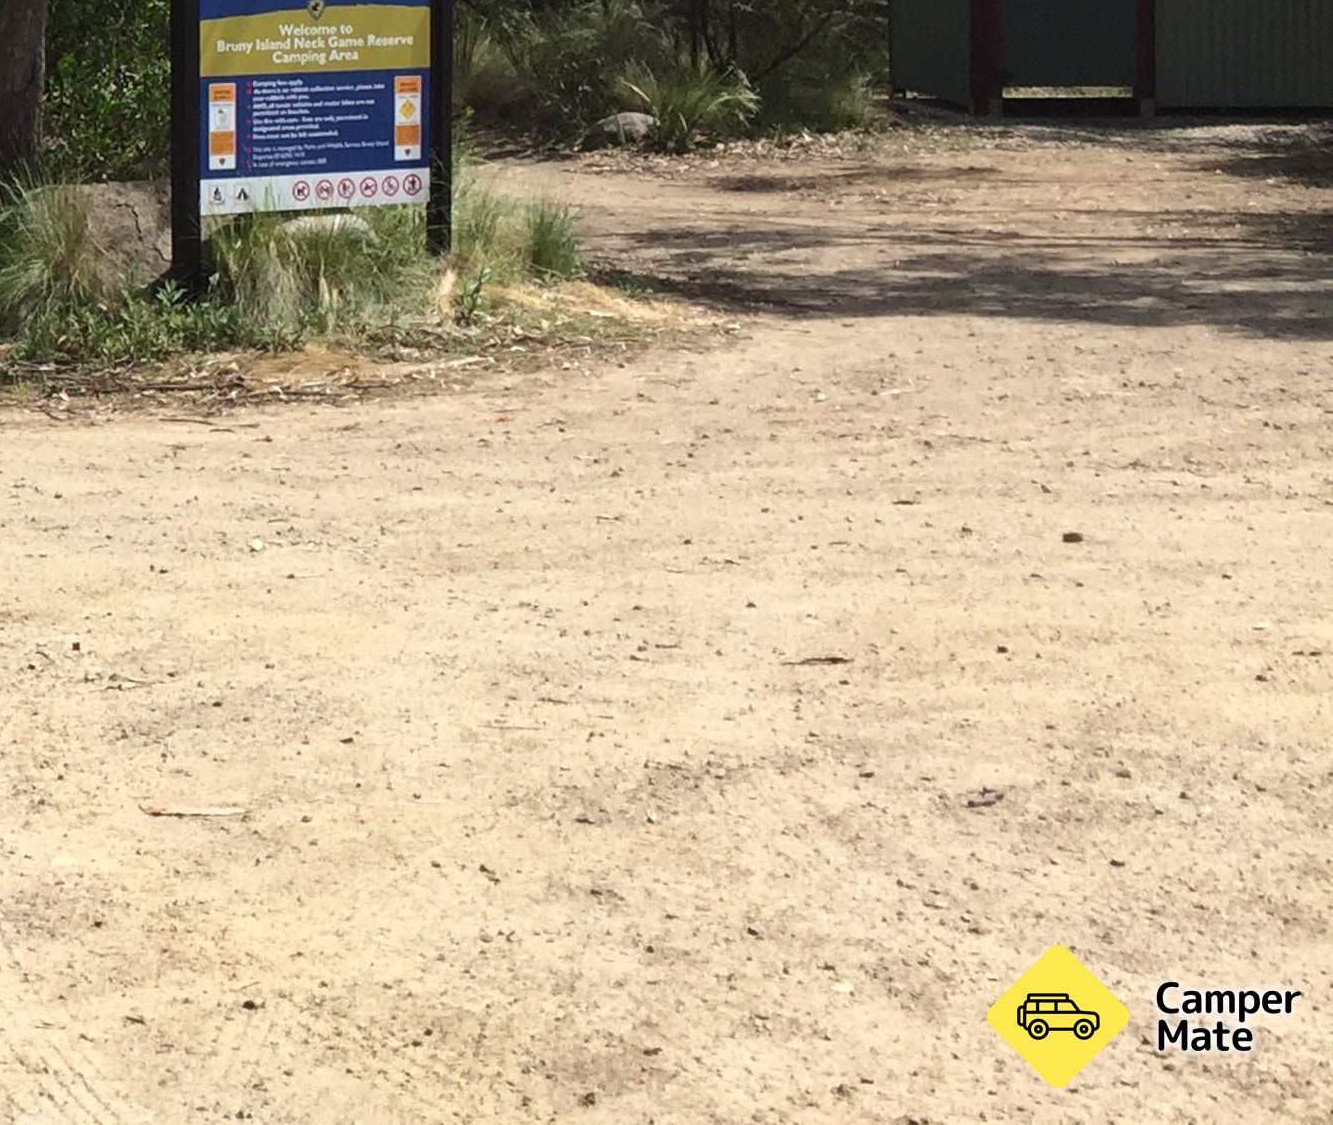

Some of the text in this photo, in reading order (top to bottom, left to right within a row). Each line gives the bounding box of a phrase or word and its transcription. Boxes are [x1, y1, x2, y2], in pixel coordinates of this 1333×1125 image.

[279, 24, 353, 36] Welcome to
[217, 35, 413, 54] Bruny Island Neck Game Reserve
[273, 50, 359, 65] Camping Area
